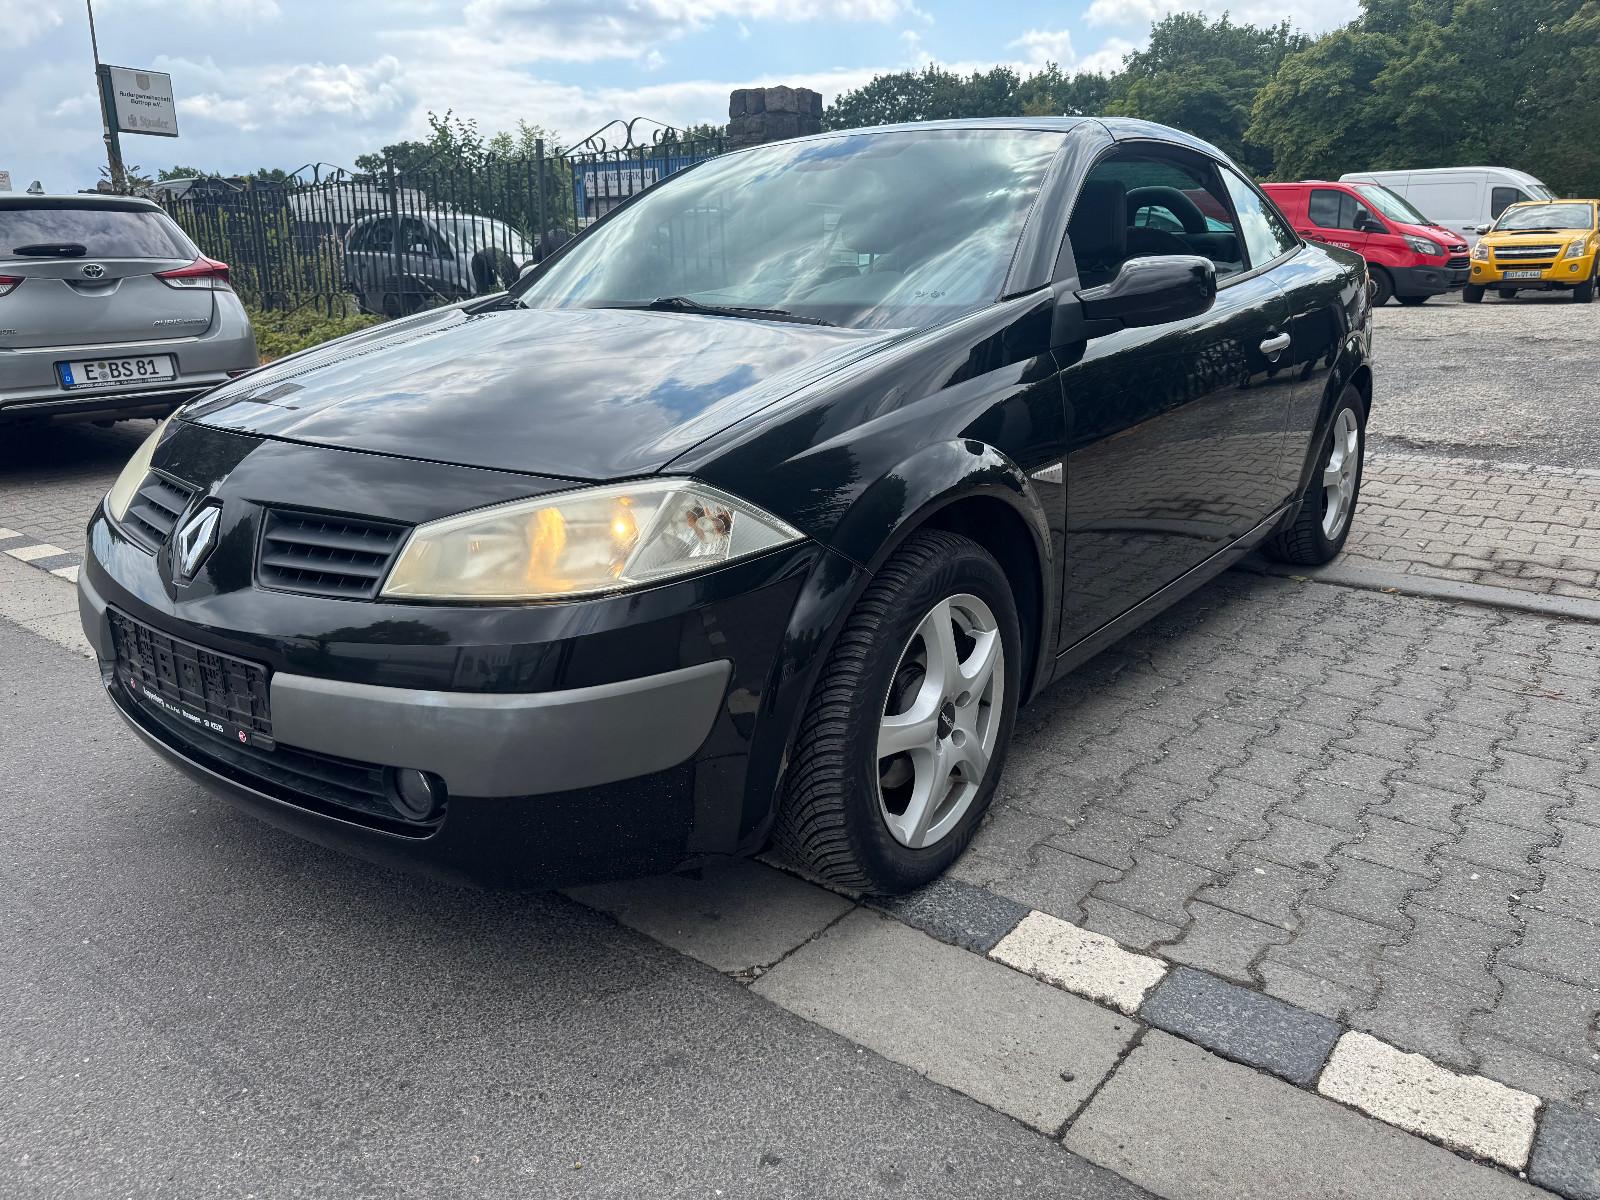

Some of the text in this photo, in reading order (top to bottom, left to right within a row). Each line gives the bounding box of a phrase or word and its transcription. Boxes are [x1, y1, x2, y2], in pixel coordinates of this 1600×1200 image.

[83, 359, 159, 381] E BS 81
